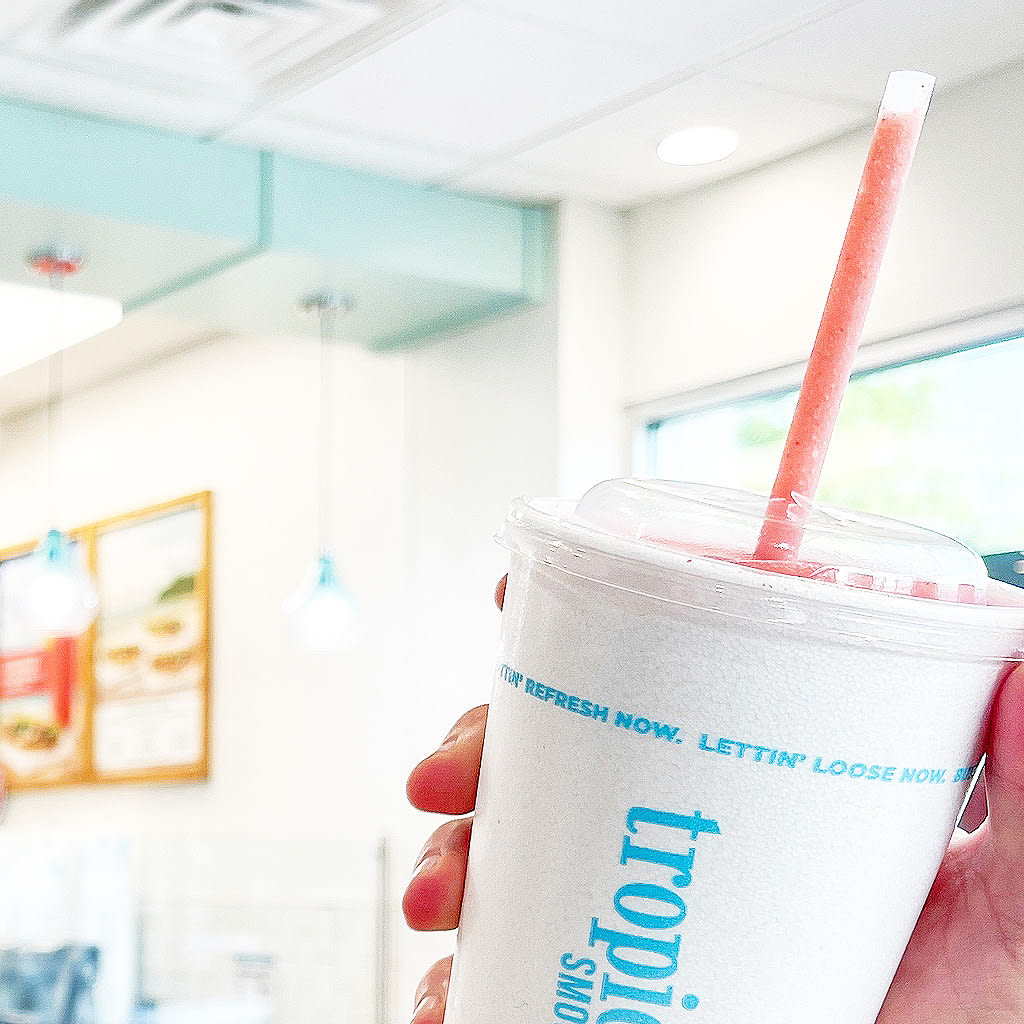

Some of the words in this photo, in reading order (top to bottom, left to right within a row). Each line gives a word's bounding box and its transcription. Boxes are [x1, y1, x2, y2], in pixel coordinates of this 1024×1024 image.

[497, 664, 523, 688] TTIN'
[525, 677, 608, 722] REFRESH
[614, 711, 682, 744] NOW.
[698, 733, 806, 769] LETTIN'
[812, 756, 896, 781] LOOSE
[899, 767, 946, 784] NOW.
